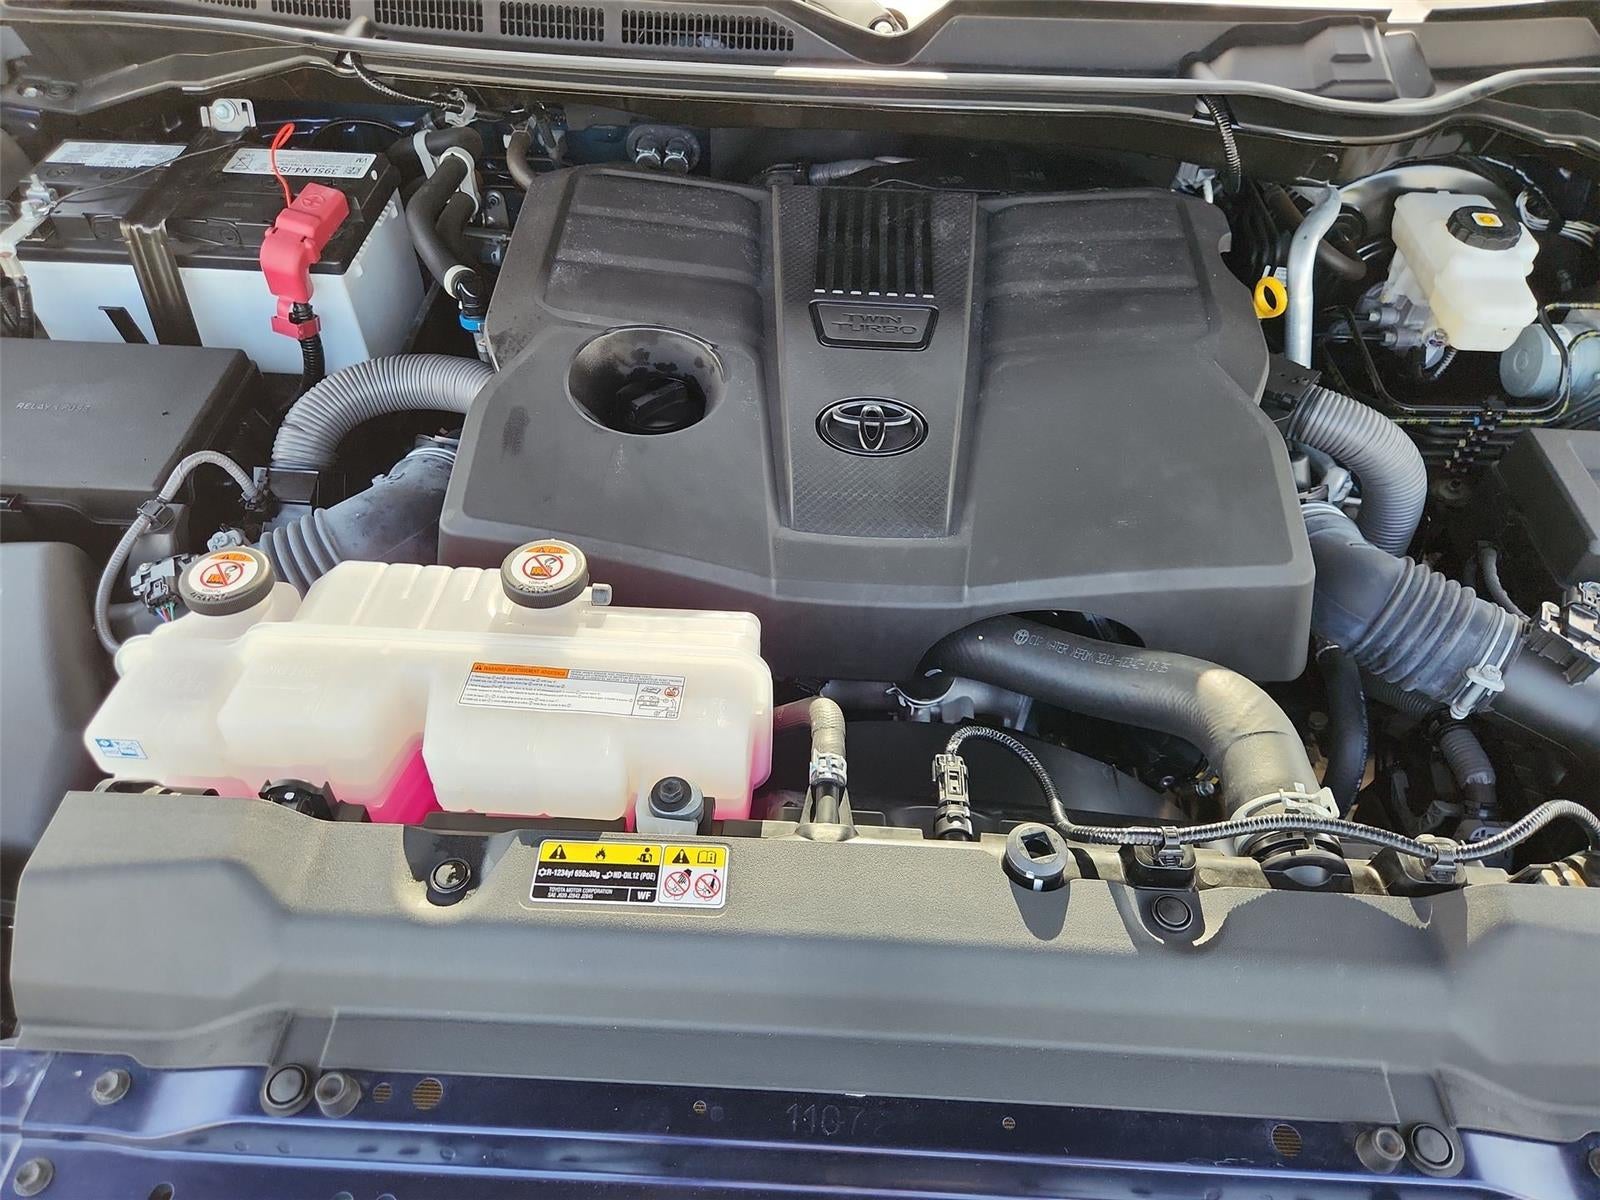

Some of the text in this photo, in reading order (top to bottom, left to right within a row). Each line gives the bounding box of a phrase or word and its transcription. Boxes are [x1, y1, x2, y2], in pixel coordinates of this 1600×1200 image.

[842, 312, 902, 324] TWIN
[832, 321, 918, 335] TURBO
[546, 868, 573, 878] R-1234yf
[640, 872, 656, 881] (POE)
[637, 891, 652, 900] WF
